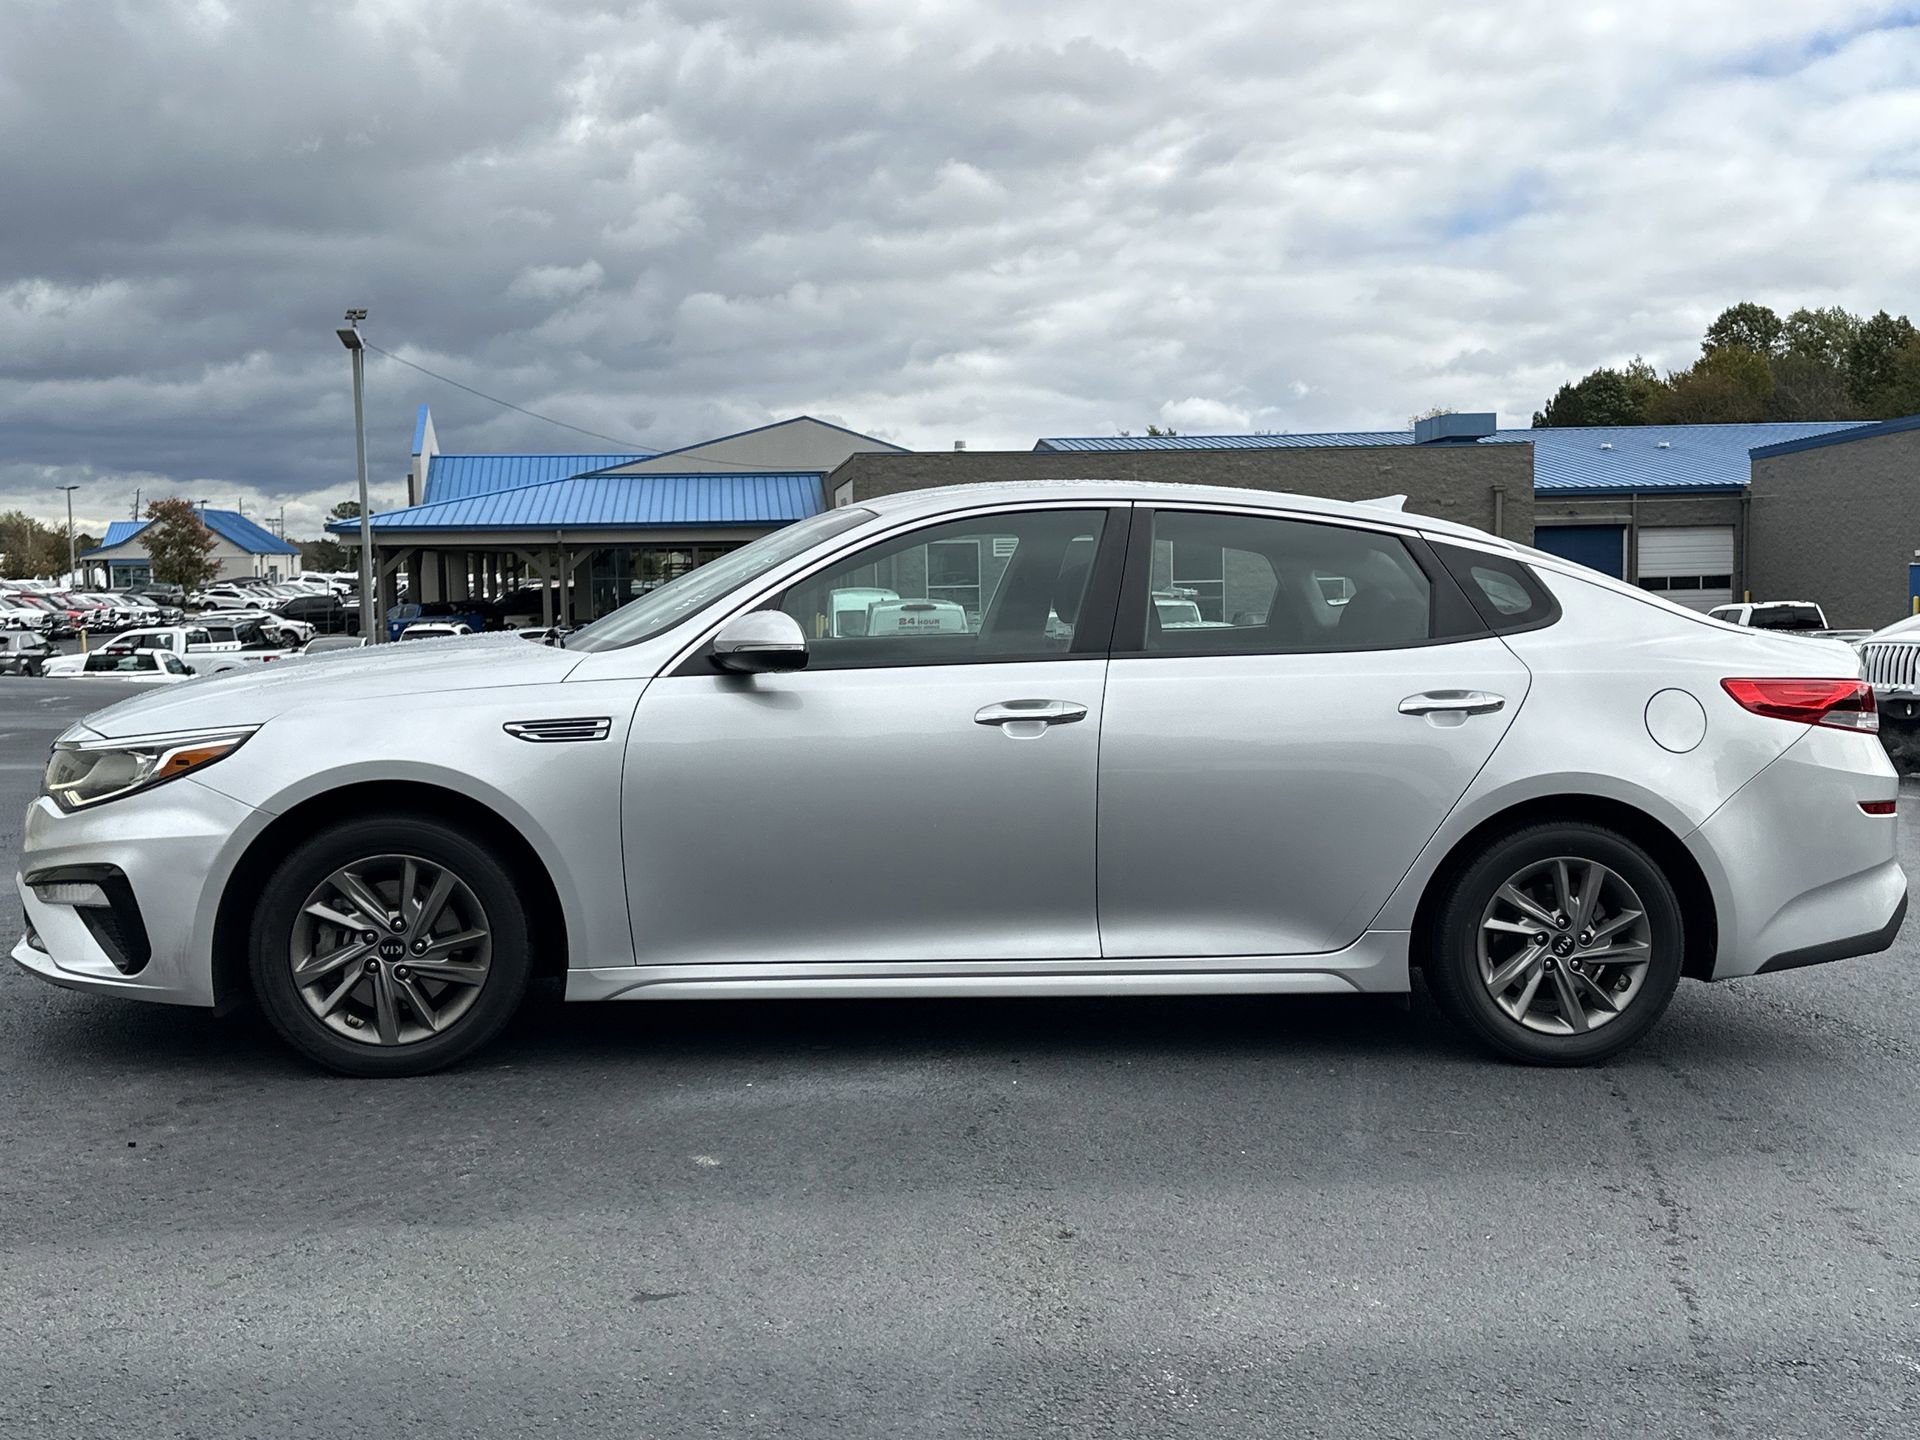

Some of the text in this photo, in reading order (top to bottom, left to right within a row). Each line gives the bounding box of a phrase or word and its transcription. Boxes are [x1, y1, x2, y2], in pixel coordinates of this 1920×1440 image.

[898, 617, 915, 625] 24
[380, 945, 403, 955] KIA
[1554, 936, 1573, 954] KIA
